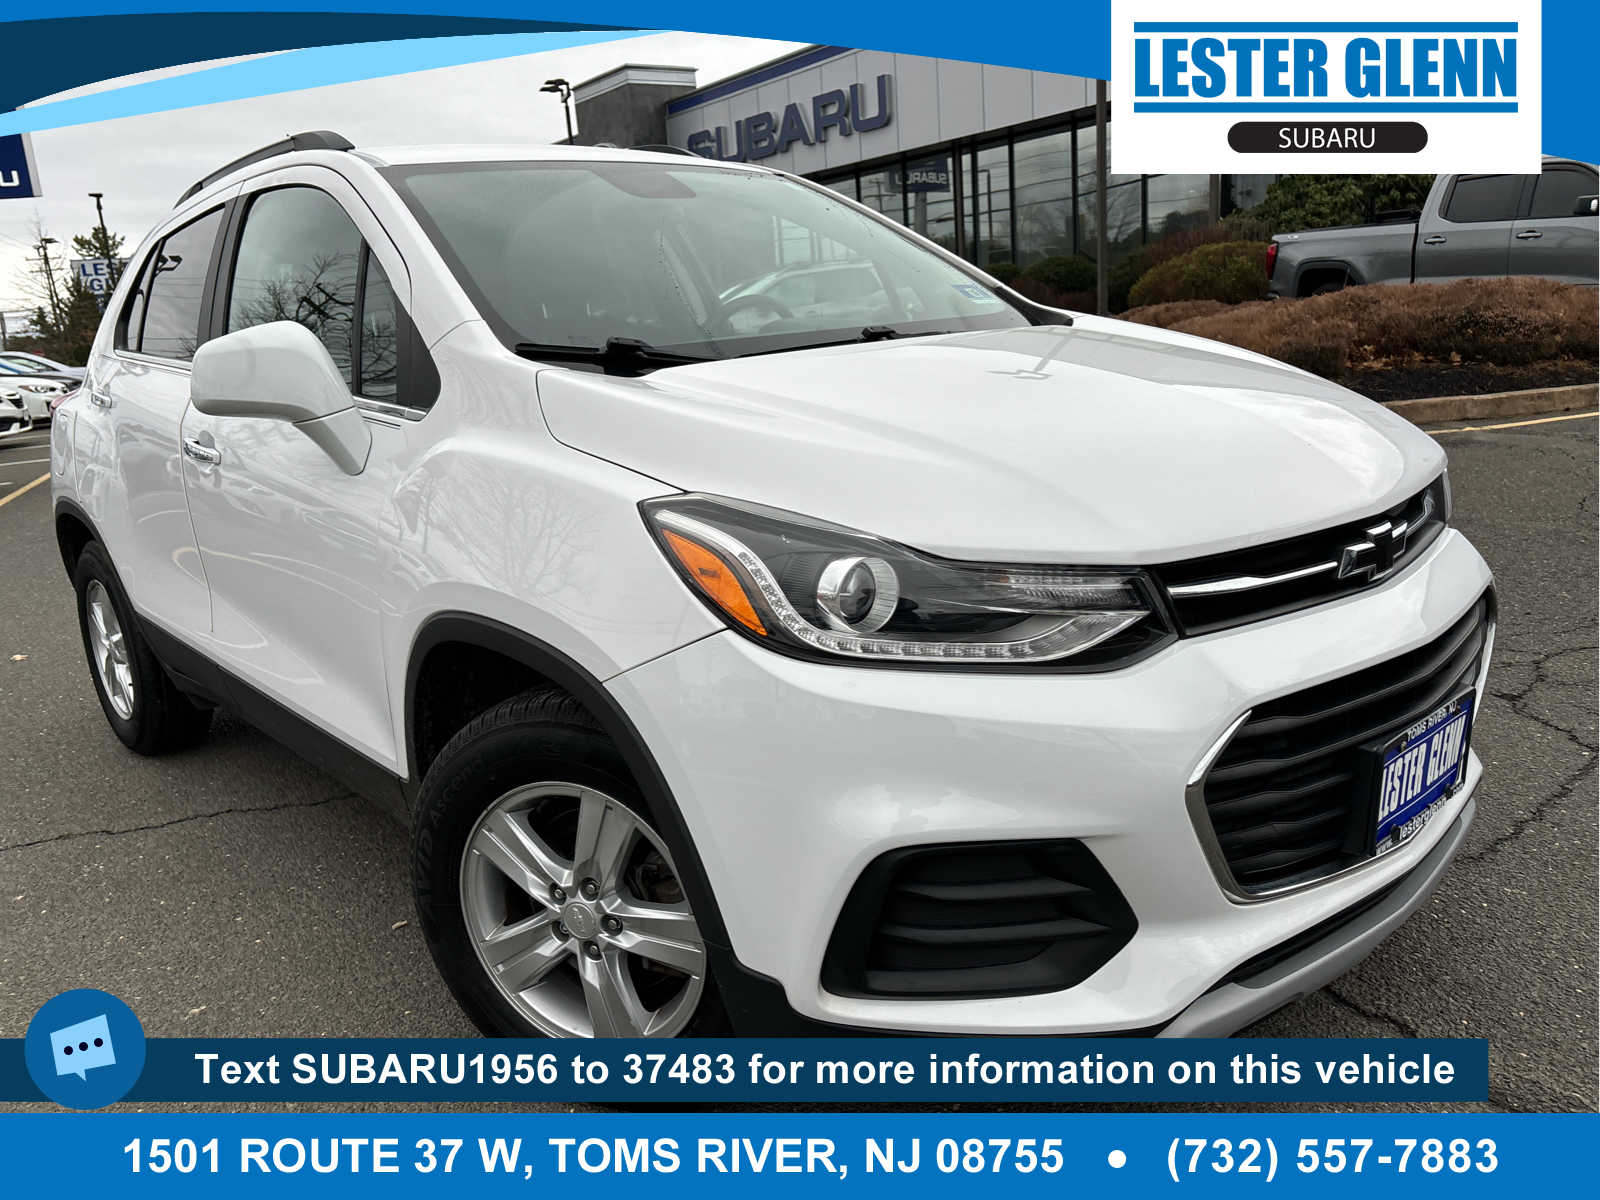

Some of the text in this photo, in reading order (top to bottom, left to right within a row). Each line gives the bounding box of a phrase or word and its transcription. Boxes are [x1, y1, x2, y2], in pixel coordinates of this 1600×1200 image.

[687, 74, 892, 163] SUBARU
[1377, 714, 1467, 823] LESTER GLENN
